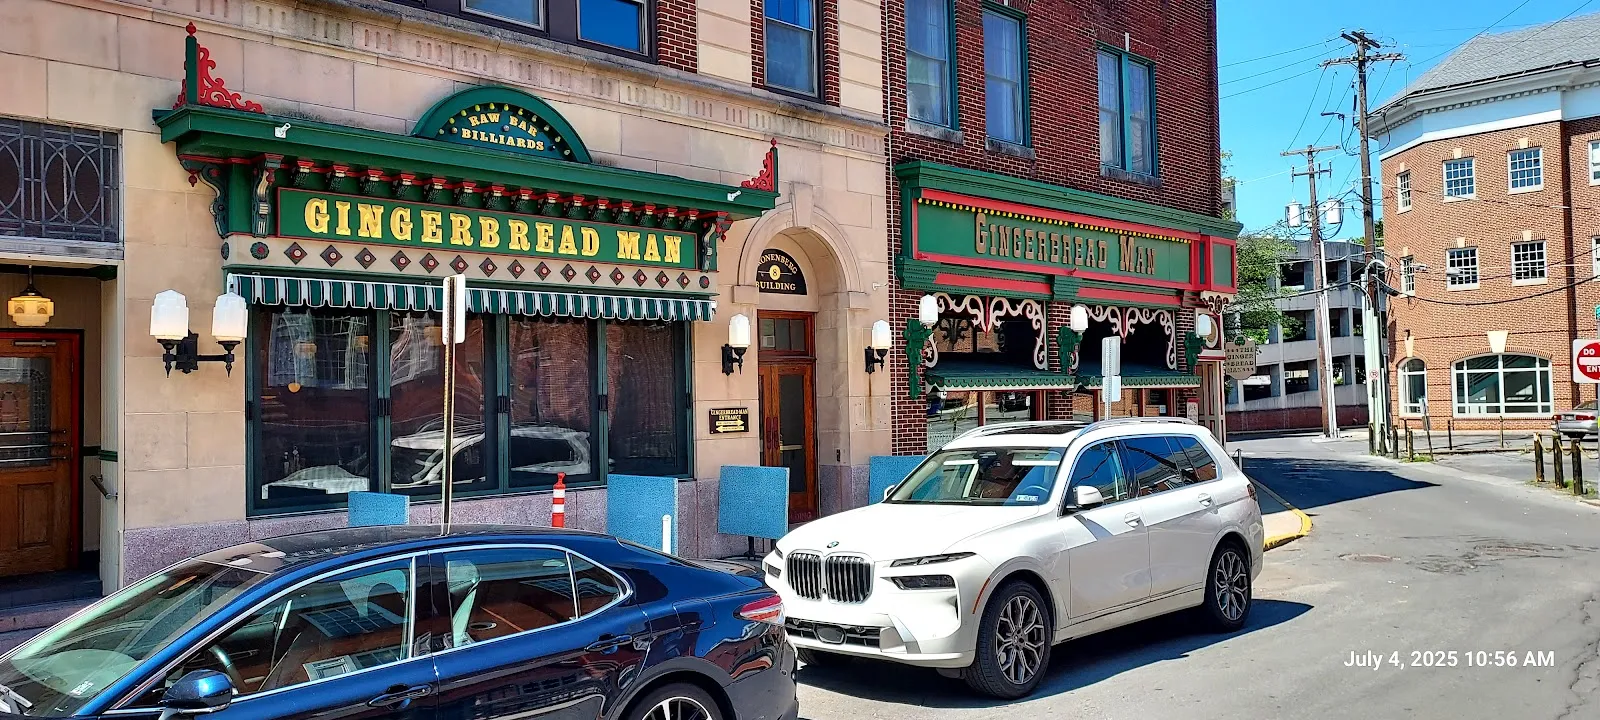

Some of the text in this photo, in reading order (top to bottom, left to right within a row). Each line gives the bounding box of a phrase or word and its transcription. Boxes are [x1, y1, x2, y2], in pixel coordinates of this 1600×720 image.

[468, 112, 539, 137] RAW BAR
[461, 127, 545, 151] BILLIARDS
[304, 197, 682, 264] GINGERBREAD MAN
[974, 212, 1156, 275] GINGERBREAD MAN
[1583, 348, 1596, 356] DO
